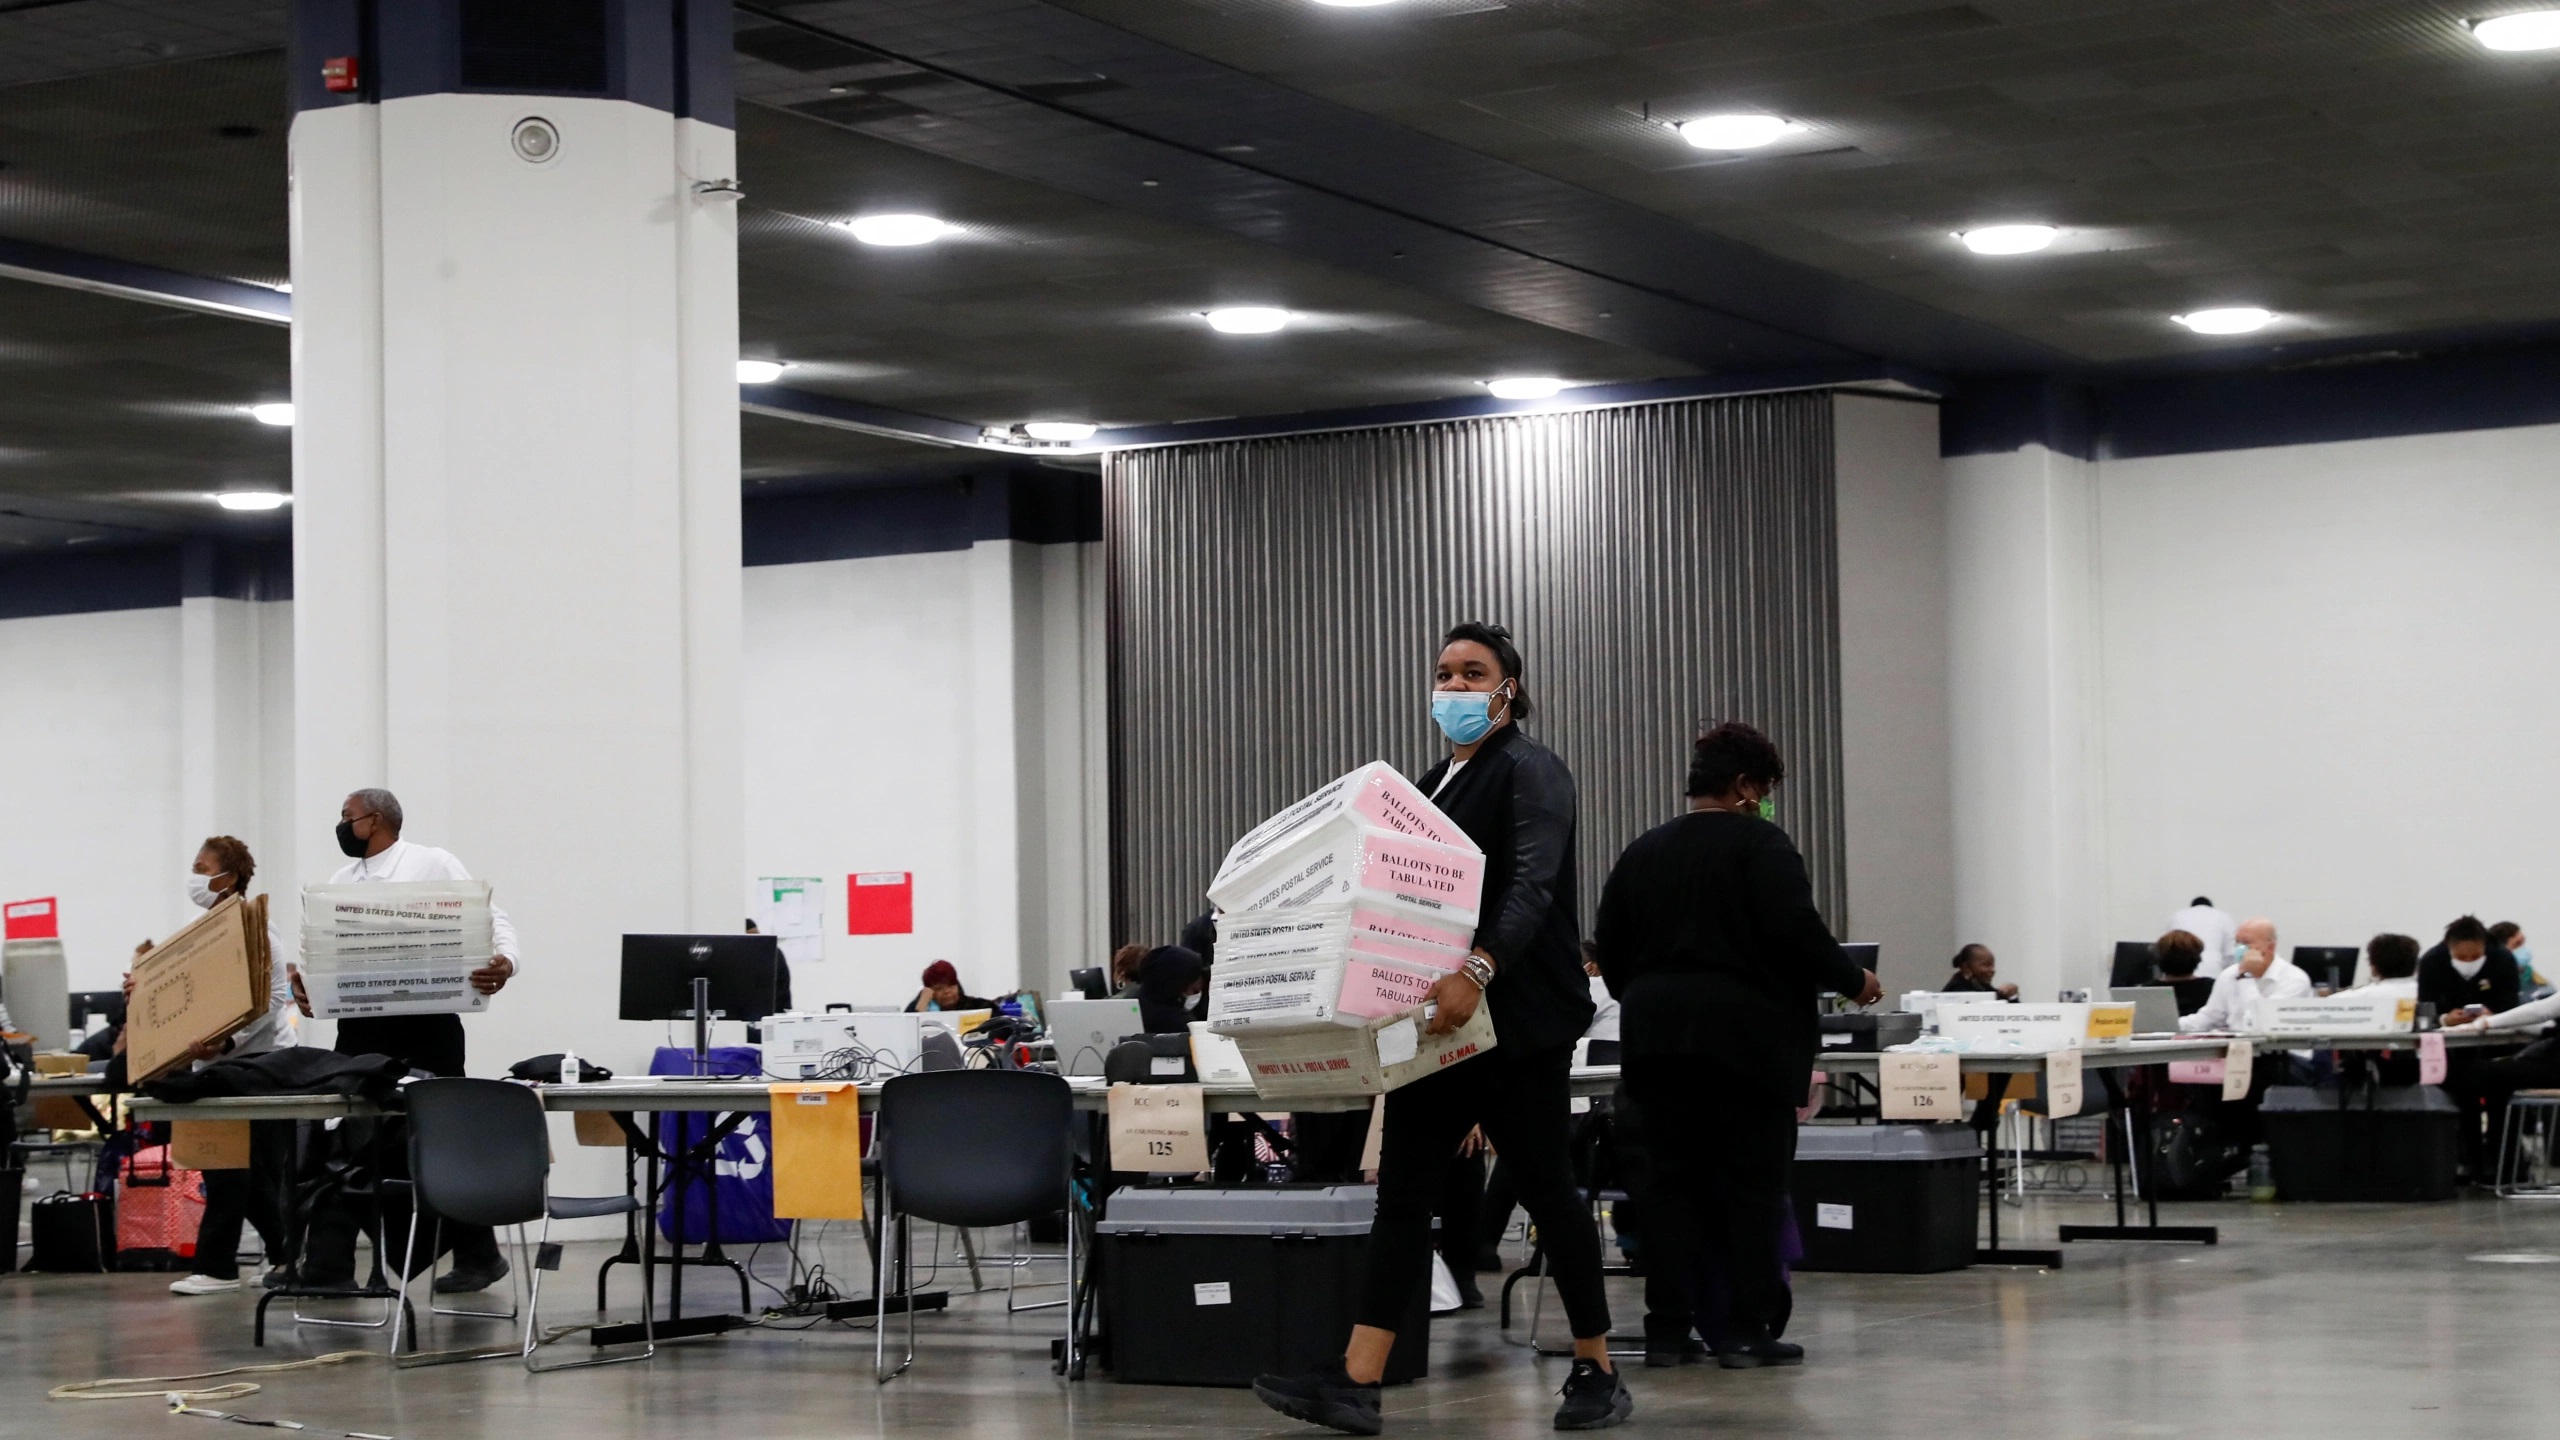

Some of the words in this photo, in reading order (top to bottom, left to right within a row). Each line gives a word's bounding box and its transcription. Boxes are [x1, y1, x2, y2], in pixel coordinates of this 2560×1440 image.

[1381, 790, 1427, 832] BALLOTS
[1381, 853, 1431, 873] BALLOTS
[1434, 865, 1450, 876] TO
[1452, 869, 1465, 880] BE
[1259, 887, 1280, 909] STATES
[1281, 872, 1305, 894] POSTAL
[1306, 852, 1334, 878] SERVICE
[1389, 869, 1455, 893] TABULATED
[1396, 893, 1417, 905] POSTAL
[1418, 898, 1442, 910] SERVICE
[335, 905, 364, 914] UNITED
[366, 908, 395, 917] STATES
[396, 911, 426, 920] POSTAL
[1250, 927, 1271, 937] STATES
[337, 981, 366, 989] UNITED
[368, 979, 397, 987] STATES
[399, 978, 429, 986] POSTAL
[431, 976, 465, 984] SERVICE
[1244, 976, 1265, 987] STATES
[1265, 973, 1288, 984] POSTAL
[1289, 970, 1316, 982] SERVICE
[1371, 968, 1413, 987] BALLOTS
[1416, 978, 1429, 990] TO
[1376, 986, 1424, 1006] TABULATE
[1304, 1061, 1327, 1072] POSTAL
[1326, 1058, 1351, 1071] SERVICE
[1913, 1095, 1934, 1107] 126
[1148, 1141, 1173, 1156] 125
